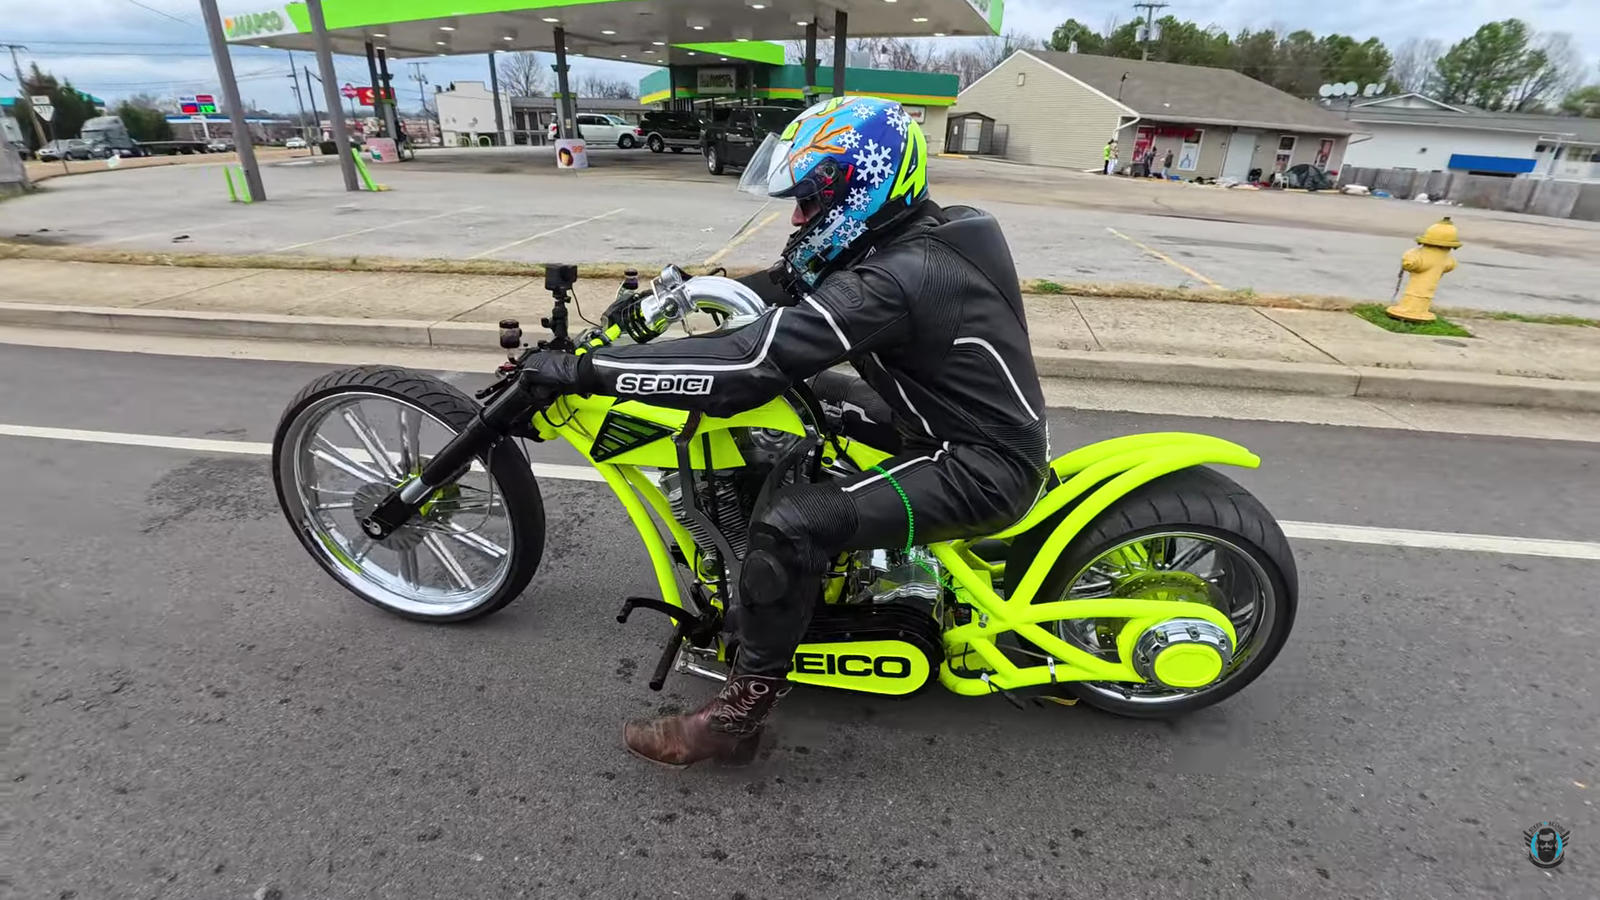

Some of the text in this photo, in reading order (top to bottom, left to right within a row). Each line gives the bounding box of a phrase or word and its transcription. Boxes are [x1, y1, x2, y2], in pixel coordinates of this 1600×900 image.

[231, 10, 284, 37] MAPCO
[617, 374, 713, 395] SEDICI
[788, 652, 911, 679] EICO
